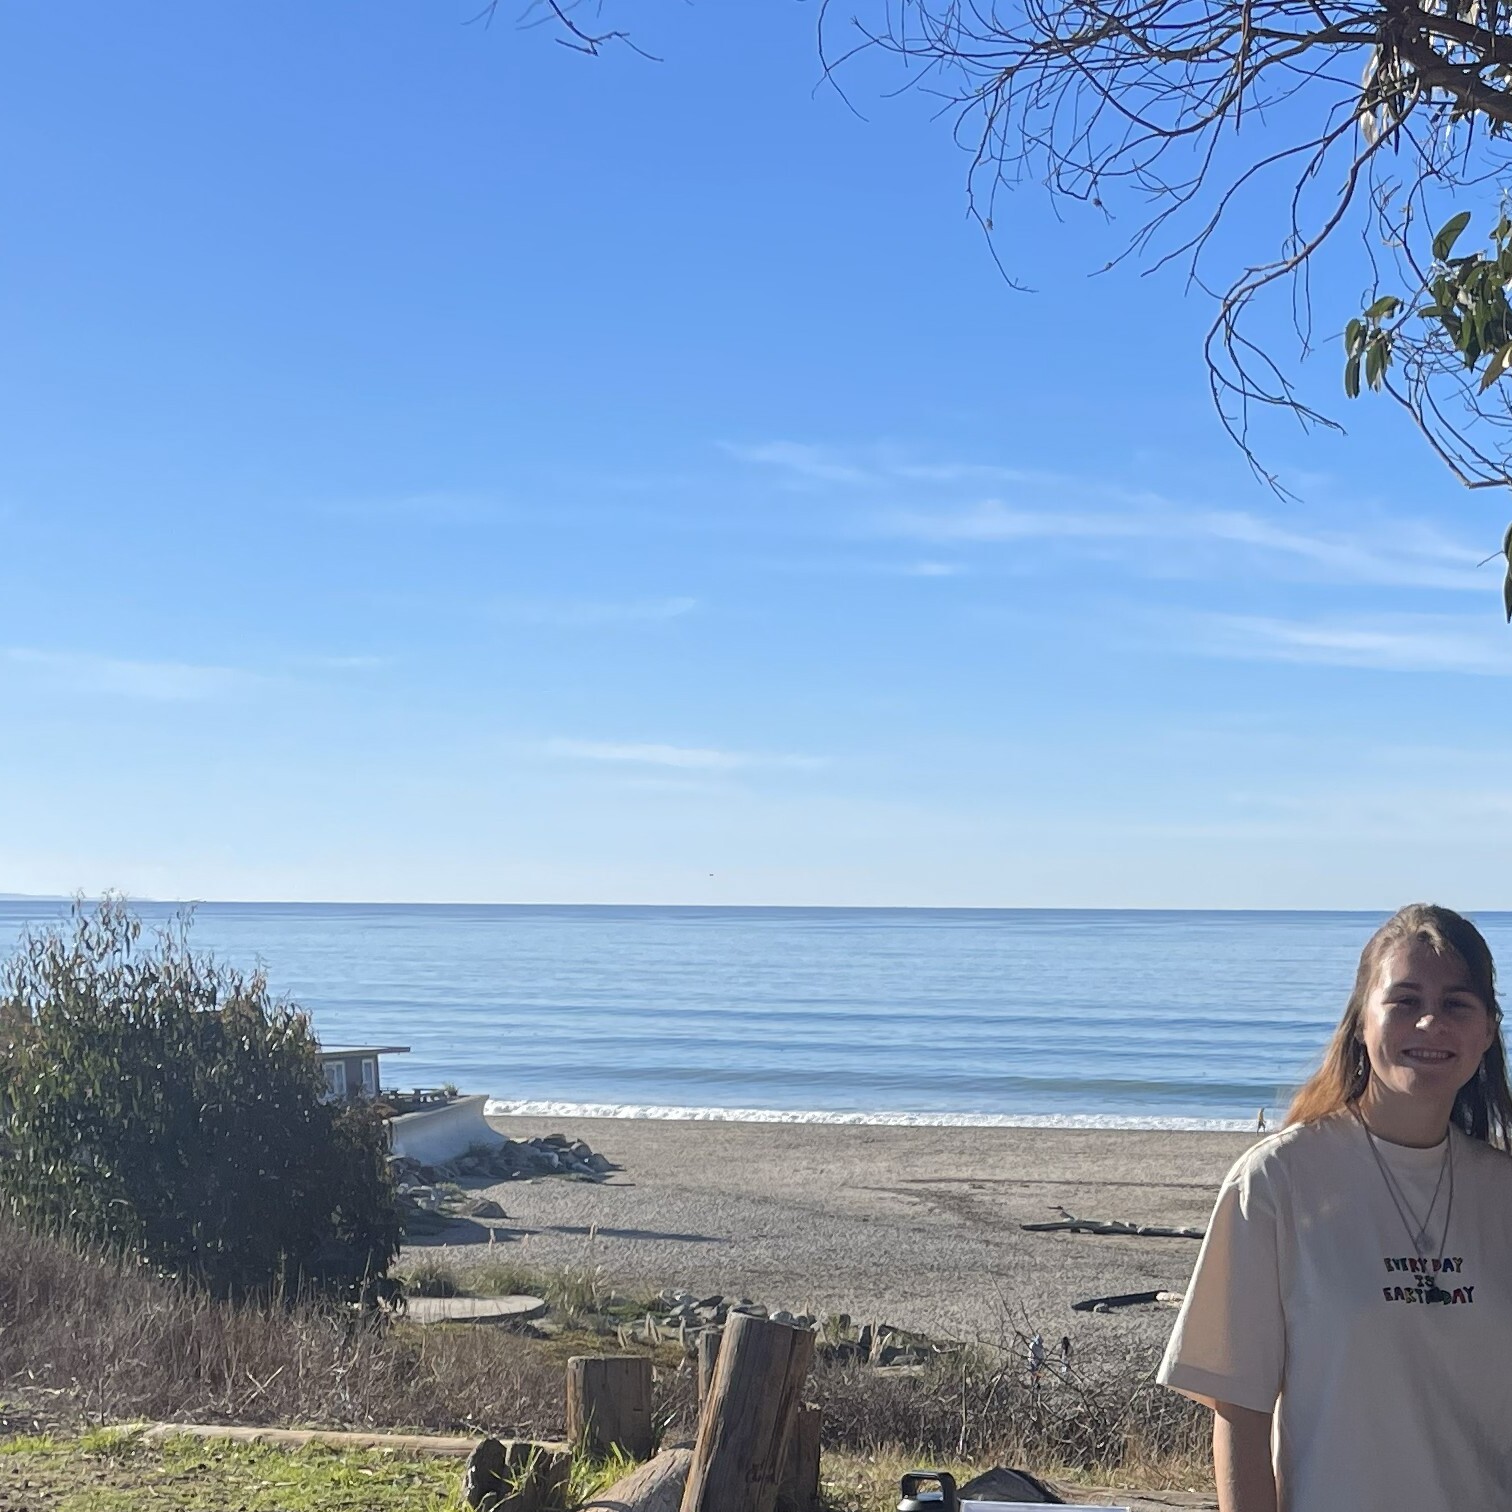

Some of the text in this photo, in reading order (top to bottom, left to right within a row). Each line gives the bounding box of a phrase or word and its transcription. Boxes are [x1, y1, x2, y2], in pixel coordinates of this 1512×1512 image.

[1383, 1257, 1463, 1273] EVERY DAY
[1414, 1275, 1435, 1287] IS
[1382, 1286, 1441, 1304] EART
